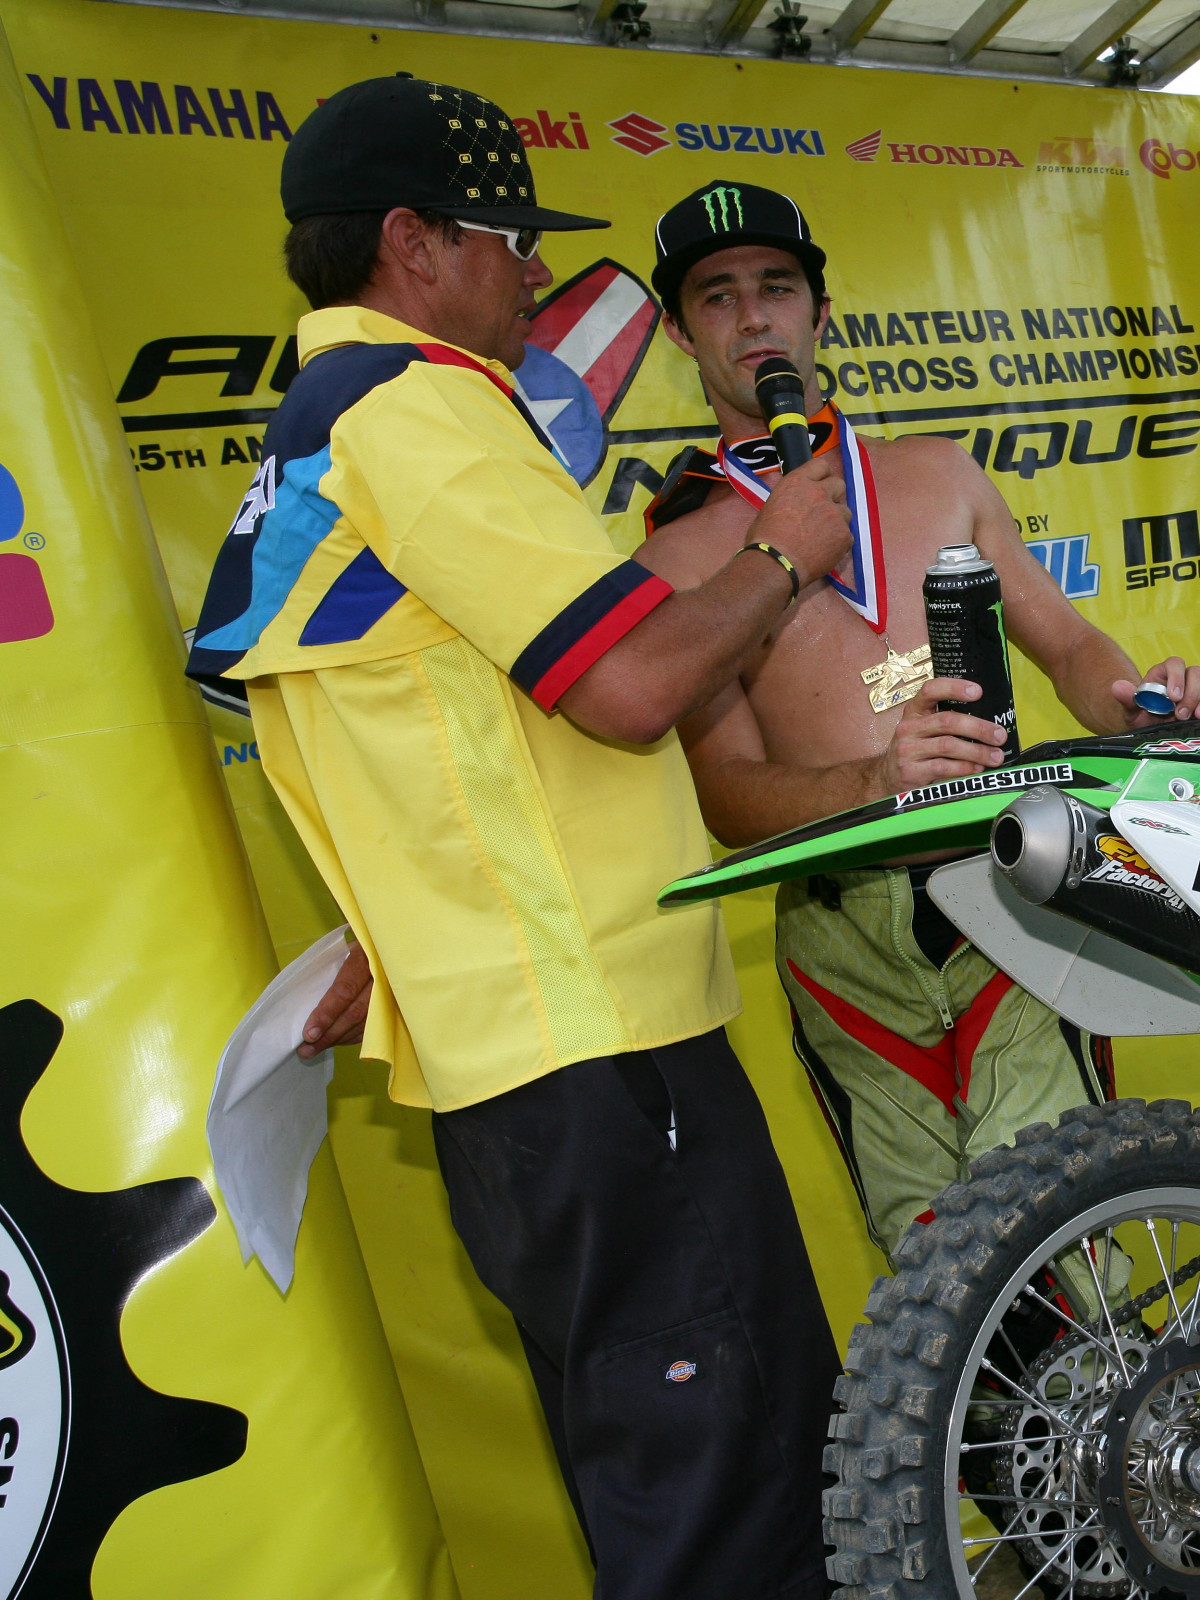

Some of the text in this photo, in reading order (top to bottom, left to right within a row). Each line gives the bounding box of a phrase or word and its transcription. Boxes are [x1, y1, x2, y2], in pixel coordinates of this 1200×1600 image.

[26, 73, 293, 142] YAMAHA
[675, 122, 825, 156] SUZUKI
[887, 142, 1024, 169] HONDA
[1037, 136, 1129, 168] KTM
[1036, 165, 1130, 176] SPORTMOTORCYCLES
[820, 304, 1195, 350] AMATEUR NATIONAL
[815, 355, 979, 400] OCROSS
[131, 443, 206, 472] 5TH
[1027, 514, 1049, 533] BY
[928, 602, 962, 610] MONSTER
[903, 764, 1071, 805] BRIDGESTONE
[1090, 859, 1175, 900] Factory
